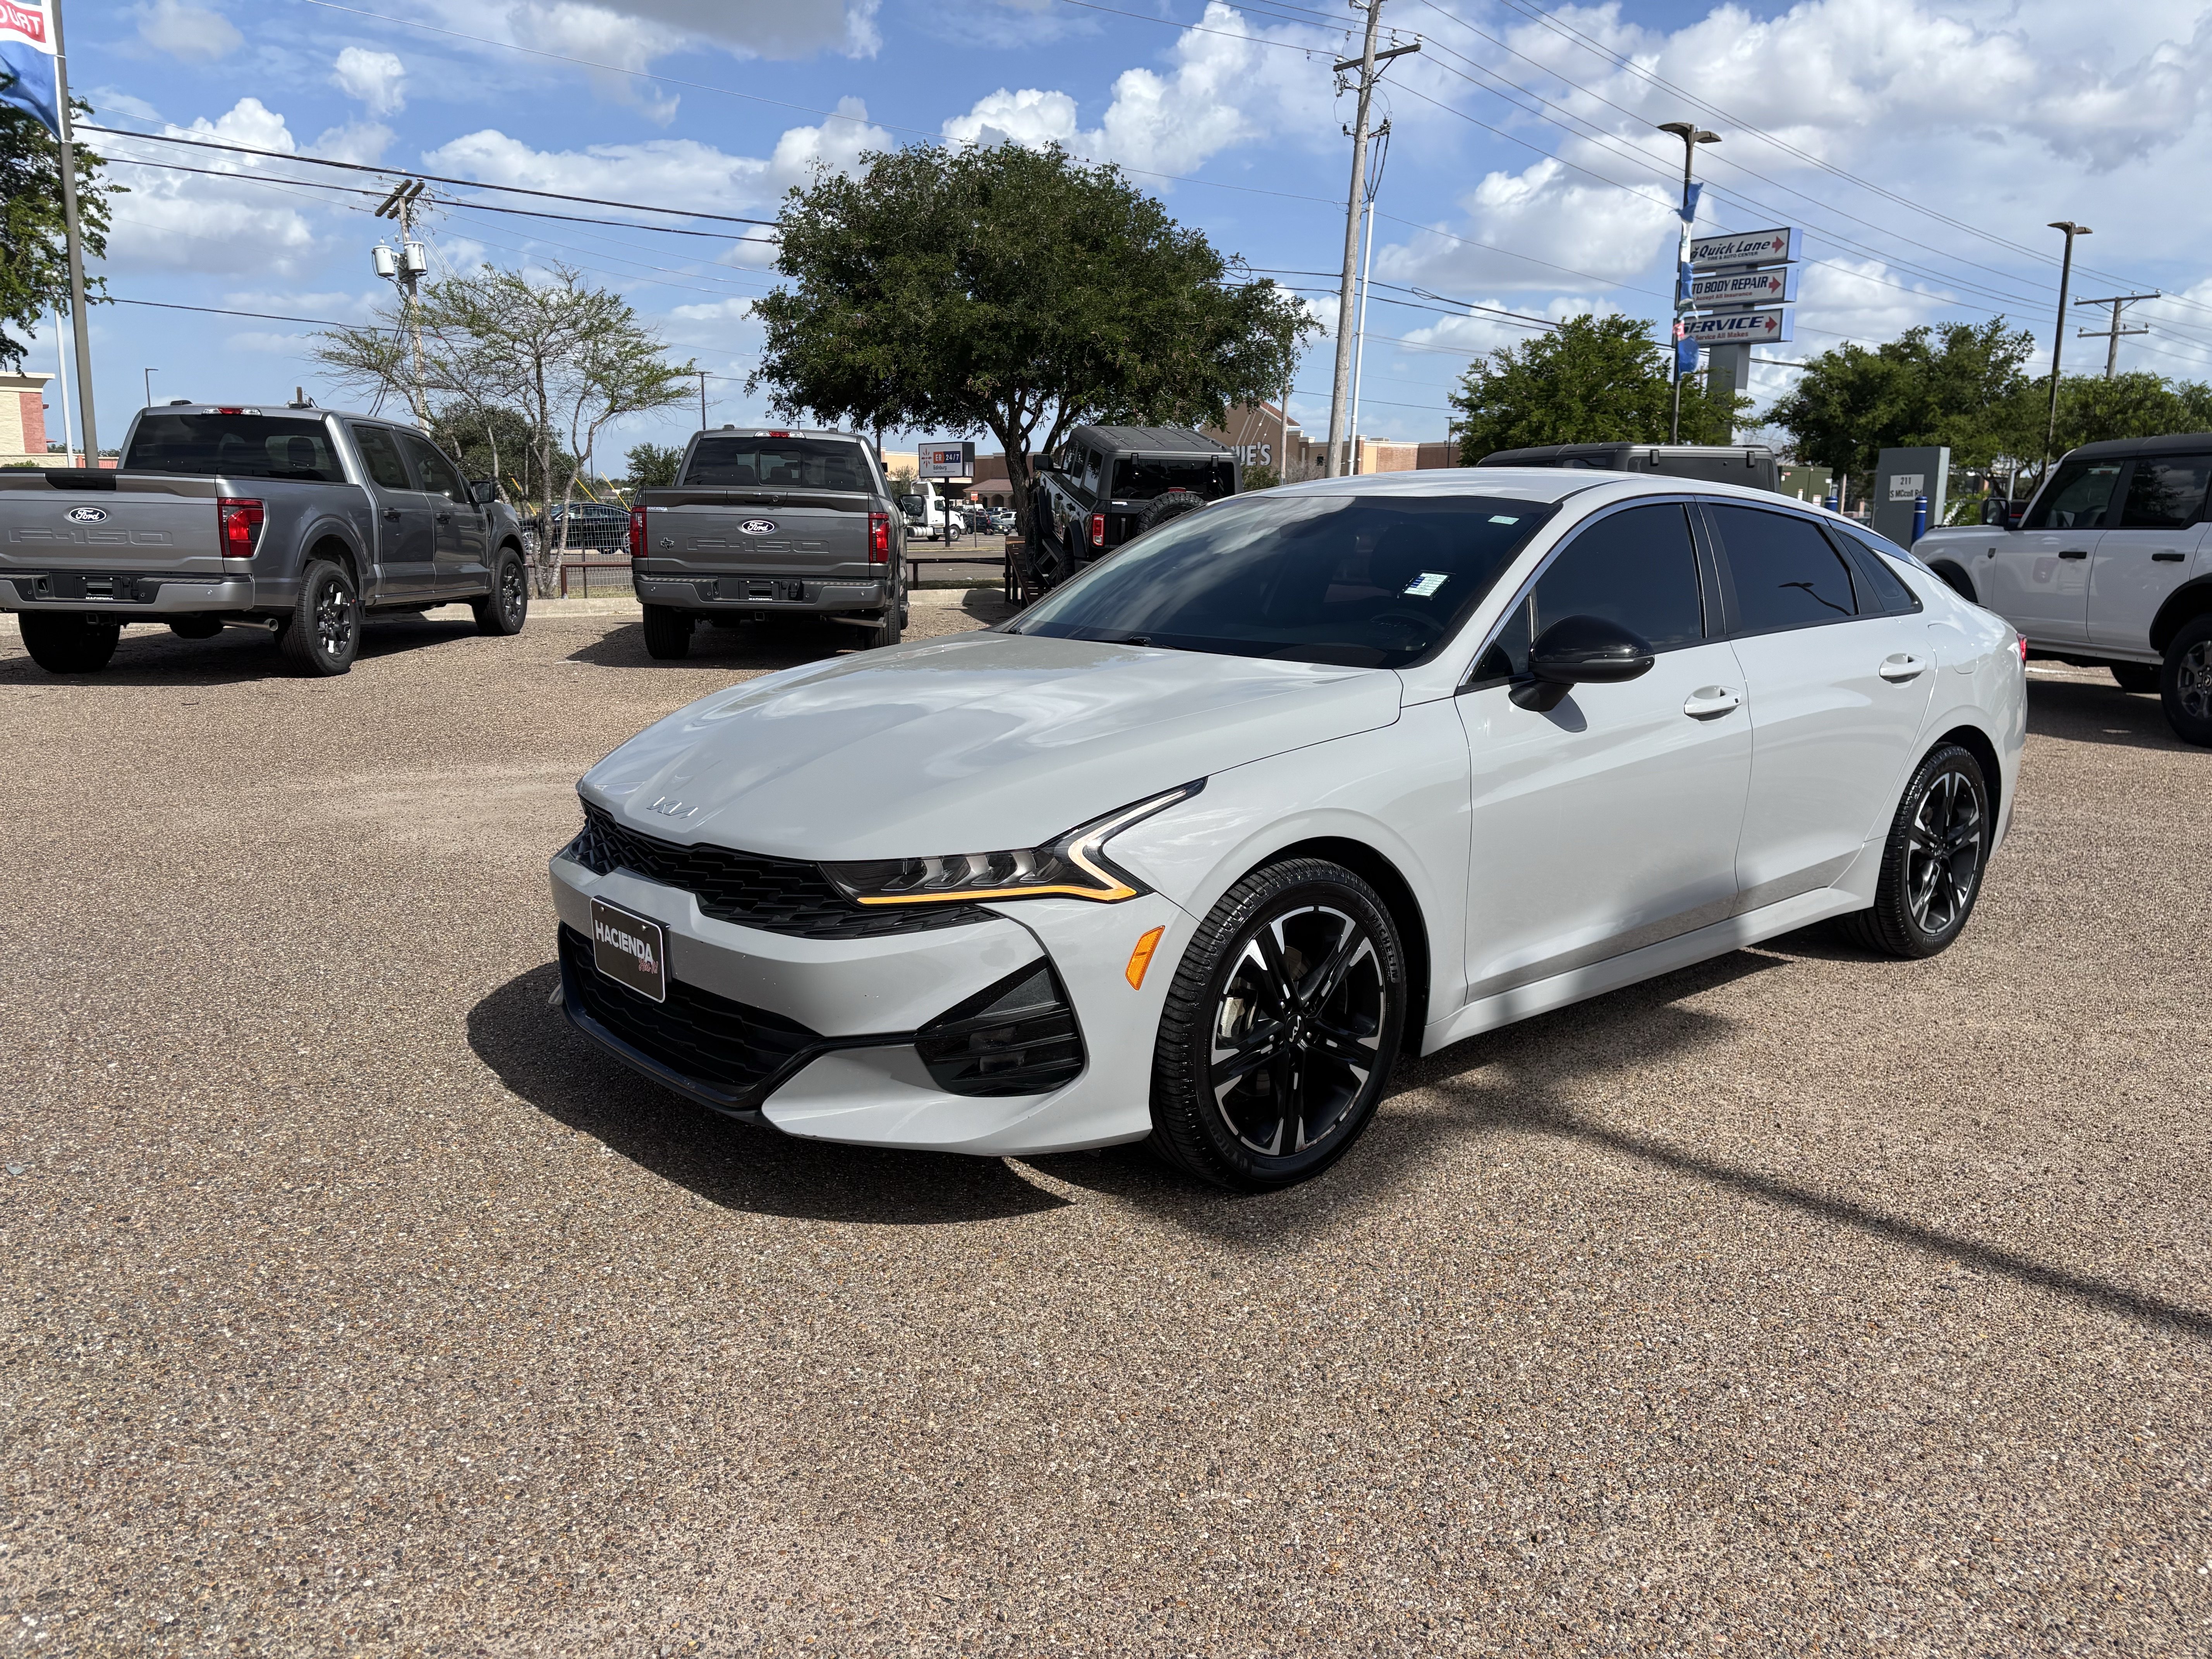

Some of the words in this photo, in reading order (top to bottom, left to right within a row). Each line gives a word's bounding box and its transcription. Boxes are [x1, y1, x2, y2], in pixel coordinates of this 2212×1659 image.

[1699, 242, 1735, 258] Quick
[1736, 241, 1771, 253] Lane
[1704, 280, 1731, 293] BODY
[1731, 276, 1768, 290] REPAIR
[1684, 316, 1764, 333] SERVICE
[1900, 477, 1911, 485] 211
[1890, 490, 1894, 498] S
[76, 509, 100, 520] Ford
[747, 522, 768, 531] Ford
[9, 527, 173, 546] F-150
[687, 537, 829, 553] F-150
[594, 919, 654, 966] HACIENDA
[1369, 913, 1399, 979] MICHELIN
